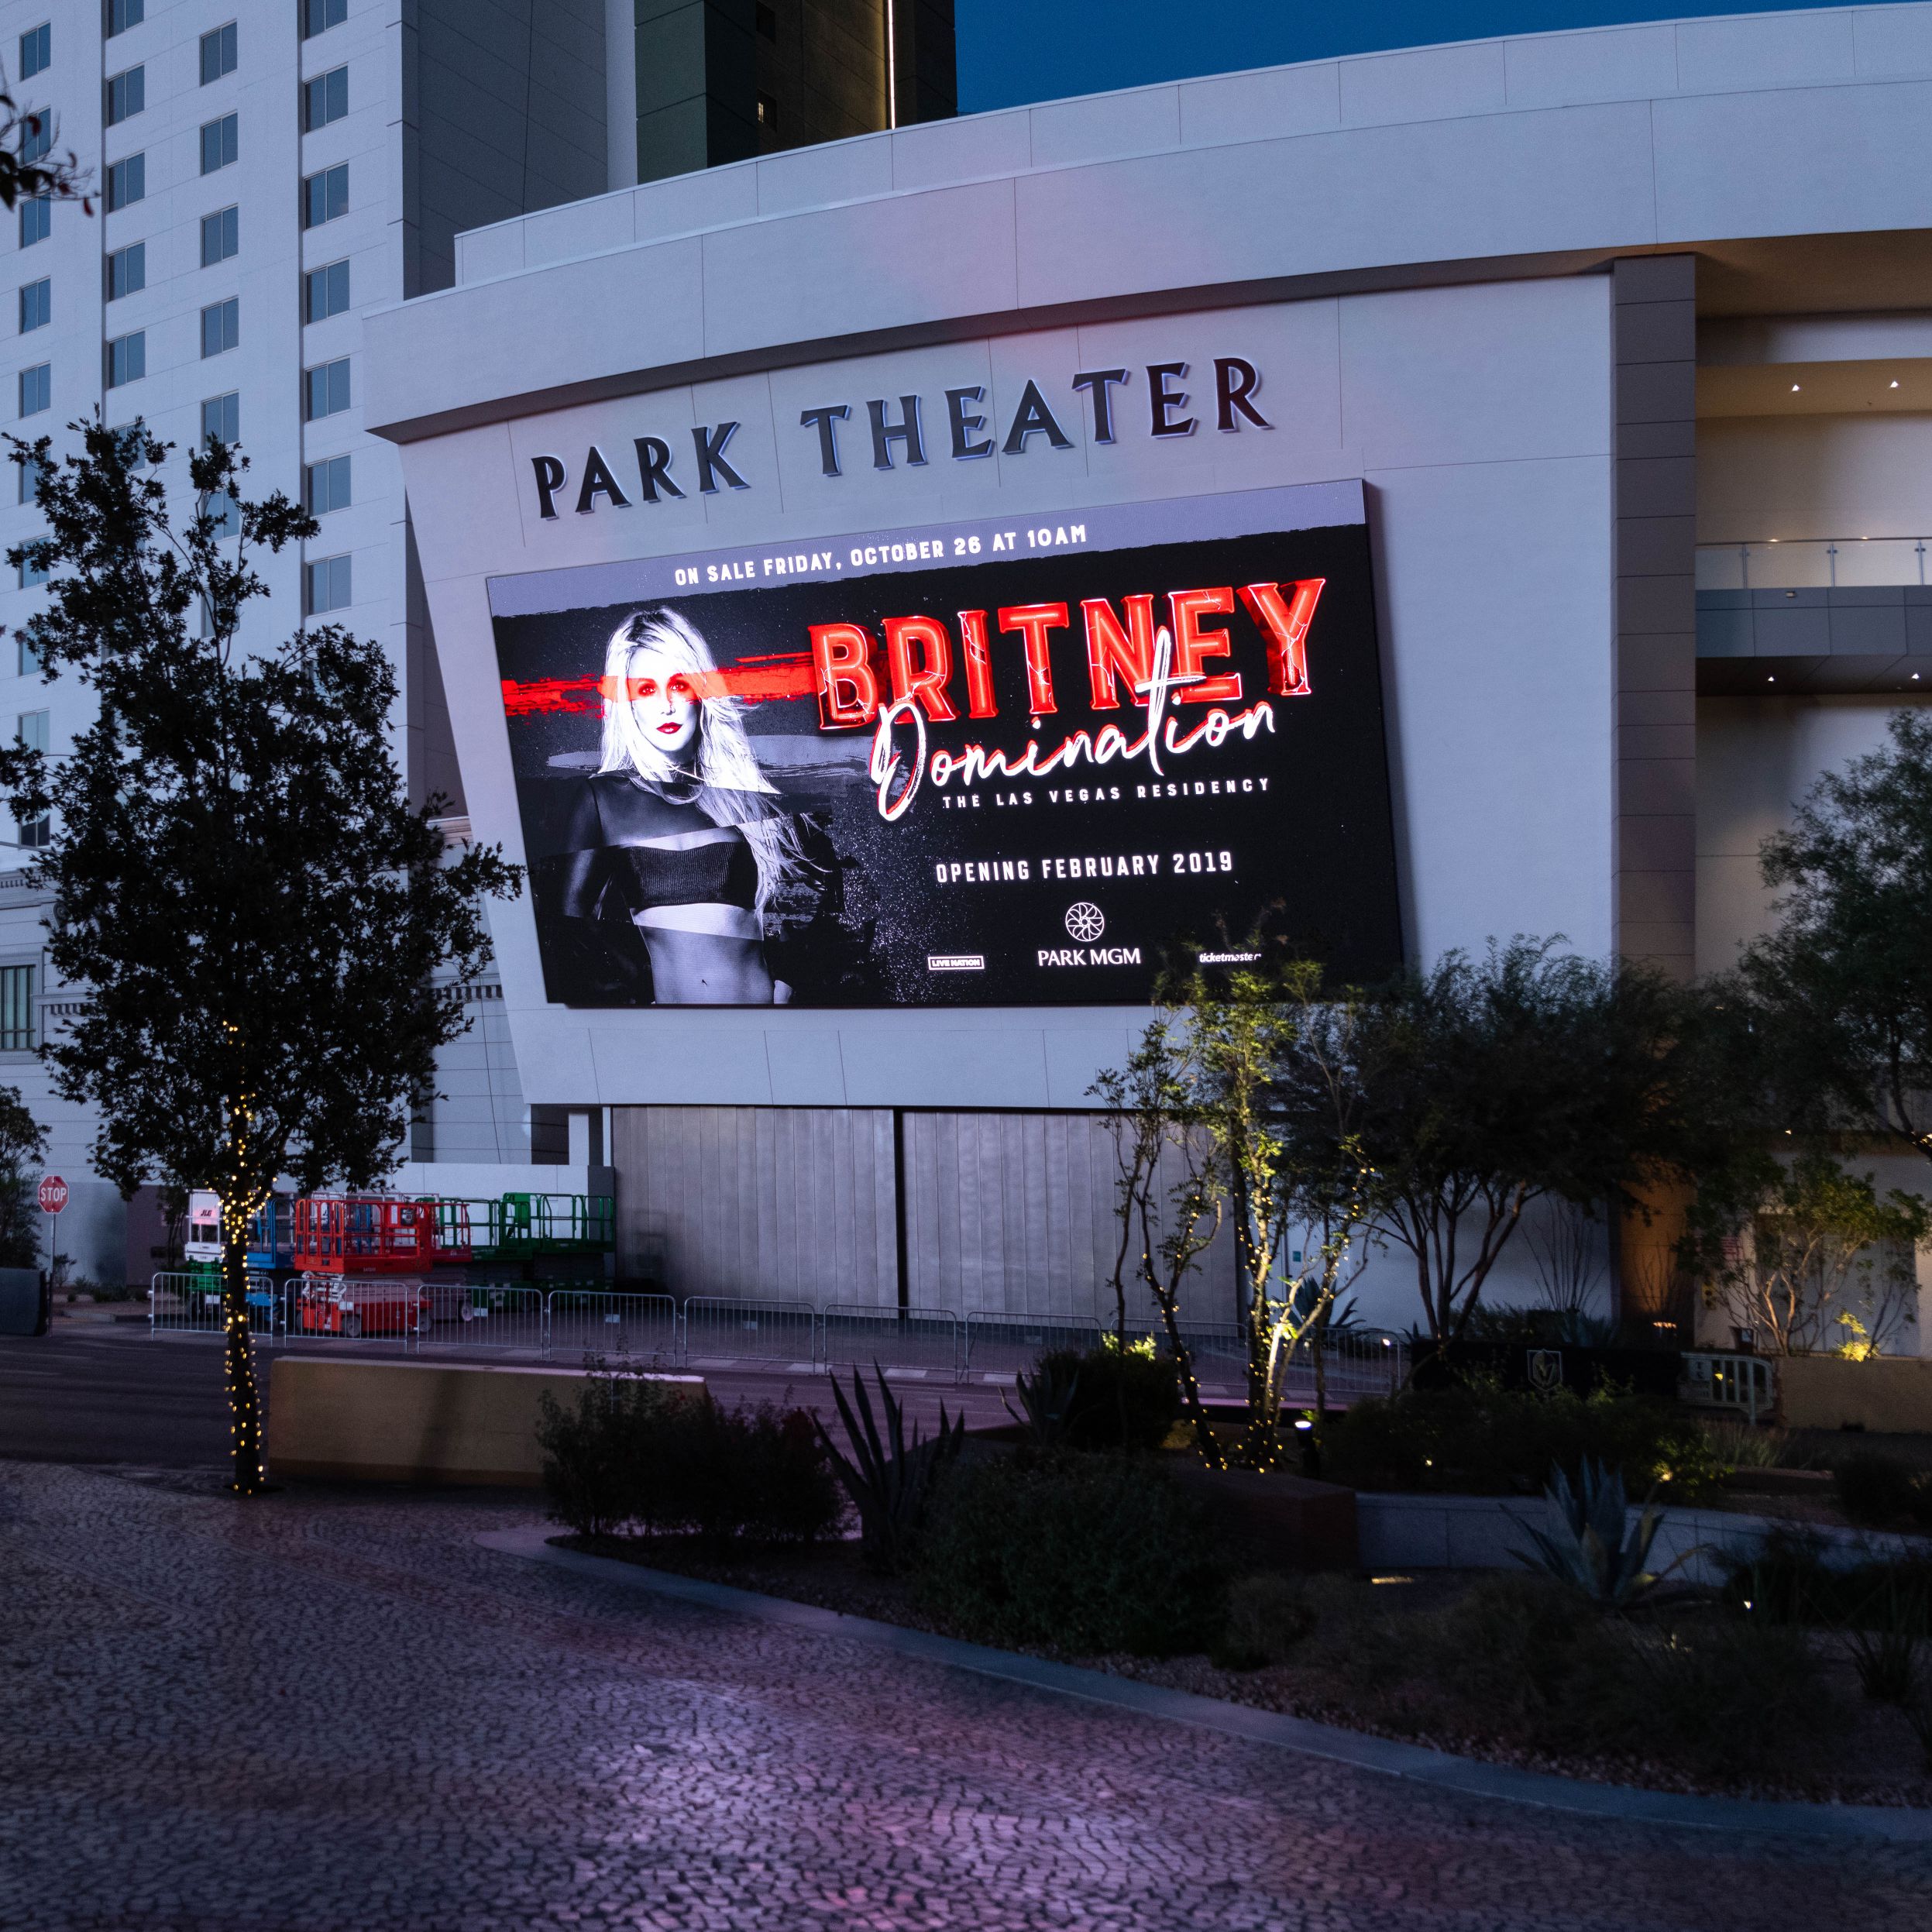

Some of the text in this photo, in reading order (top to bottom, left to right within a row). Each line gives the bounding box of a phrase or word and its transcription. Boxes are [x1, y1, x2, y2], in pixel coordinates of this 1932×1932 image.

[531, 356, 1270, 521] PARK THEATER
[674, 524, 1088, 586] ON SALE FRIDAY, OCTOBER 26 AT 10AM
[807, 578, 1326, 730] BRITNEY
[869, 626, 1276, 822] Domination
[942, 778, 1269, 809] THE LAS VEGAS RESIDENCY
[936, 851, 1232, 883] OPENING FEBRUARY 2019
[951, 958, 981, 967] NATION
[1037, 947, 1141, 967] PARK MGM
[1199, 952, 1262, 963] ticketmaster
[40, 1187, 67, 1201] STOP
